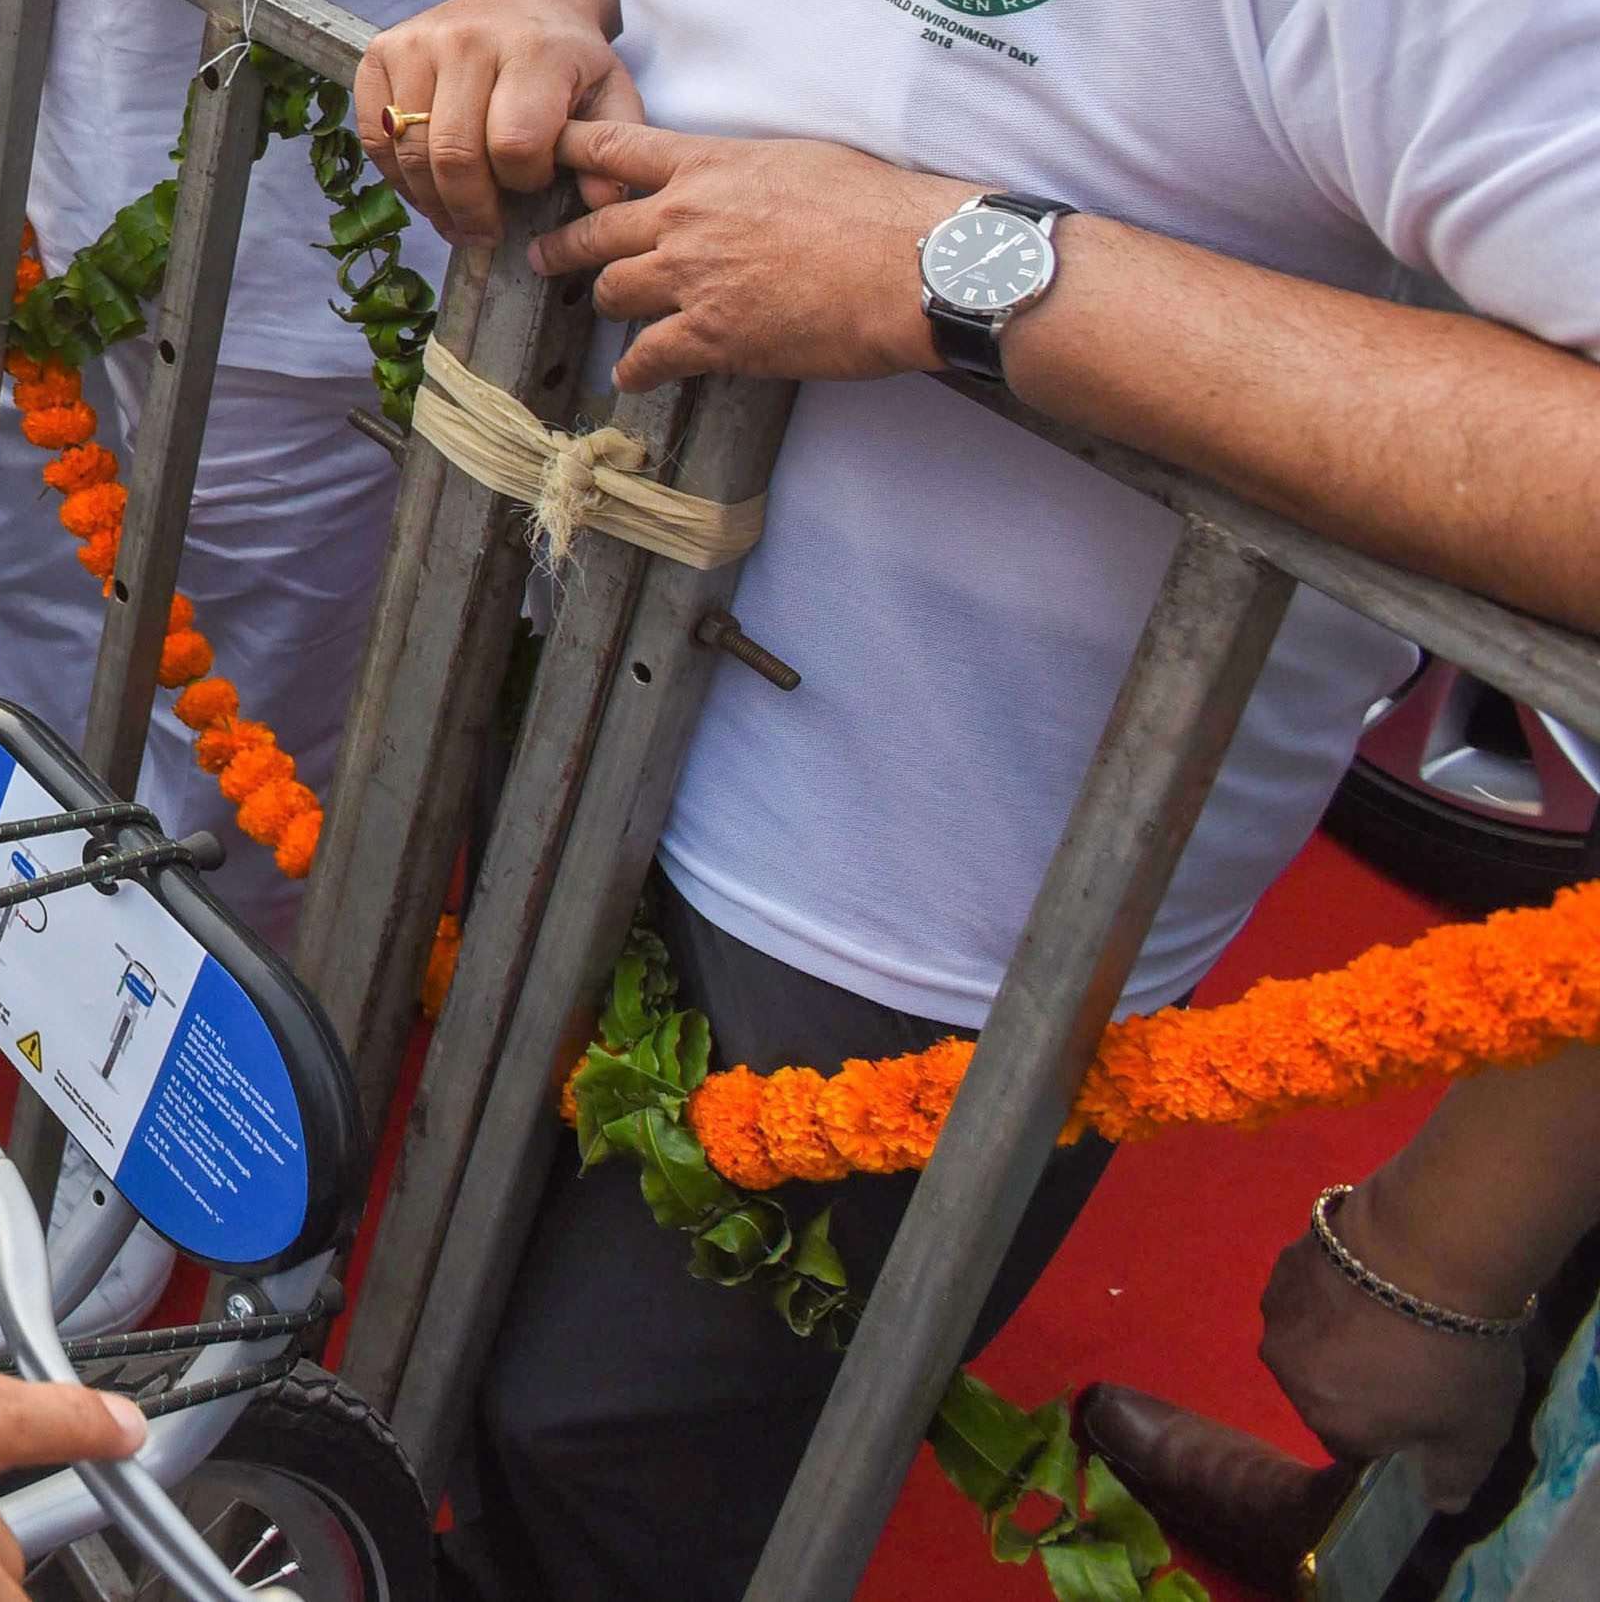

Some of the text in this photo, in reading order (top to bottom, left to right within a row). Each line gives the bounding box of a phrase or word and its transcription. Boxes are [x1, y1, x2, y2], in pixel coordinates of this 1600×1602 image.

[911, 3, 1006, 53] ENVIRONMENT
[1007, 44, 1039, 66] DAY
[920, 28, 953, 49] 2018
[195, 1014, 227, 1049] RENTAL
[185, 1041, 196, 1056] and
[197, 1054, 214, 1074] press
[190, 1024, 275, 1114] Enter the lock code into the
[171, 1075, 204, 1112] RETURN
[240, 1087, 251, 1102] tap
[252, 1100, 282, 1133] customer
[283, 1132, 298, 1150] card
[149, 1127, 170, 1151] PARK
